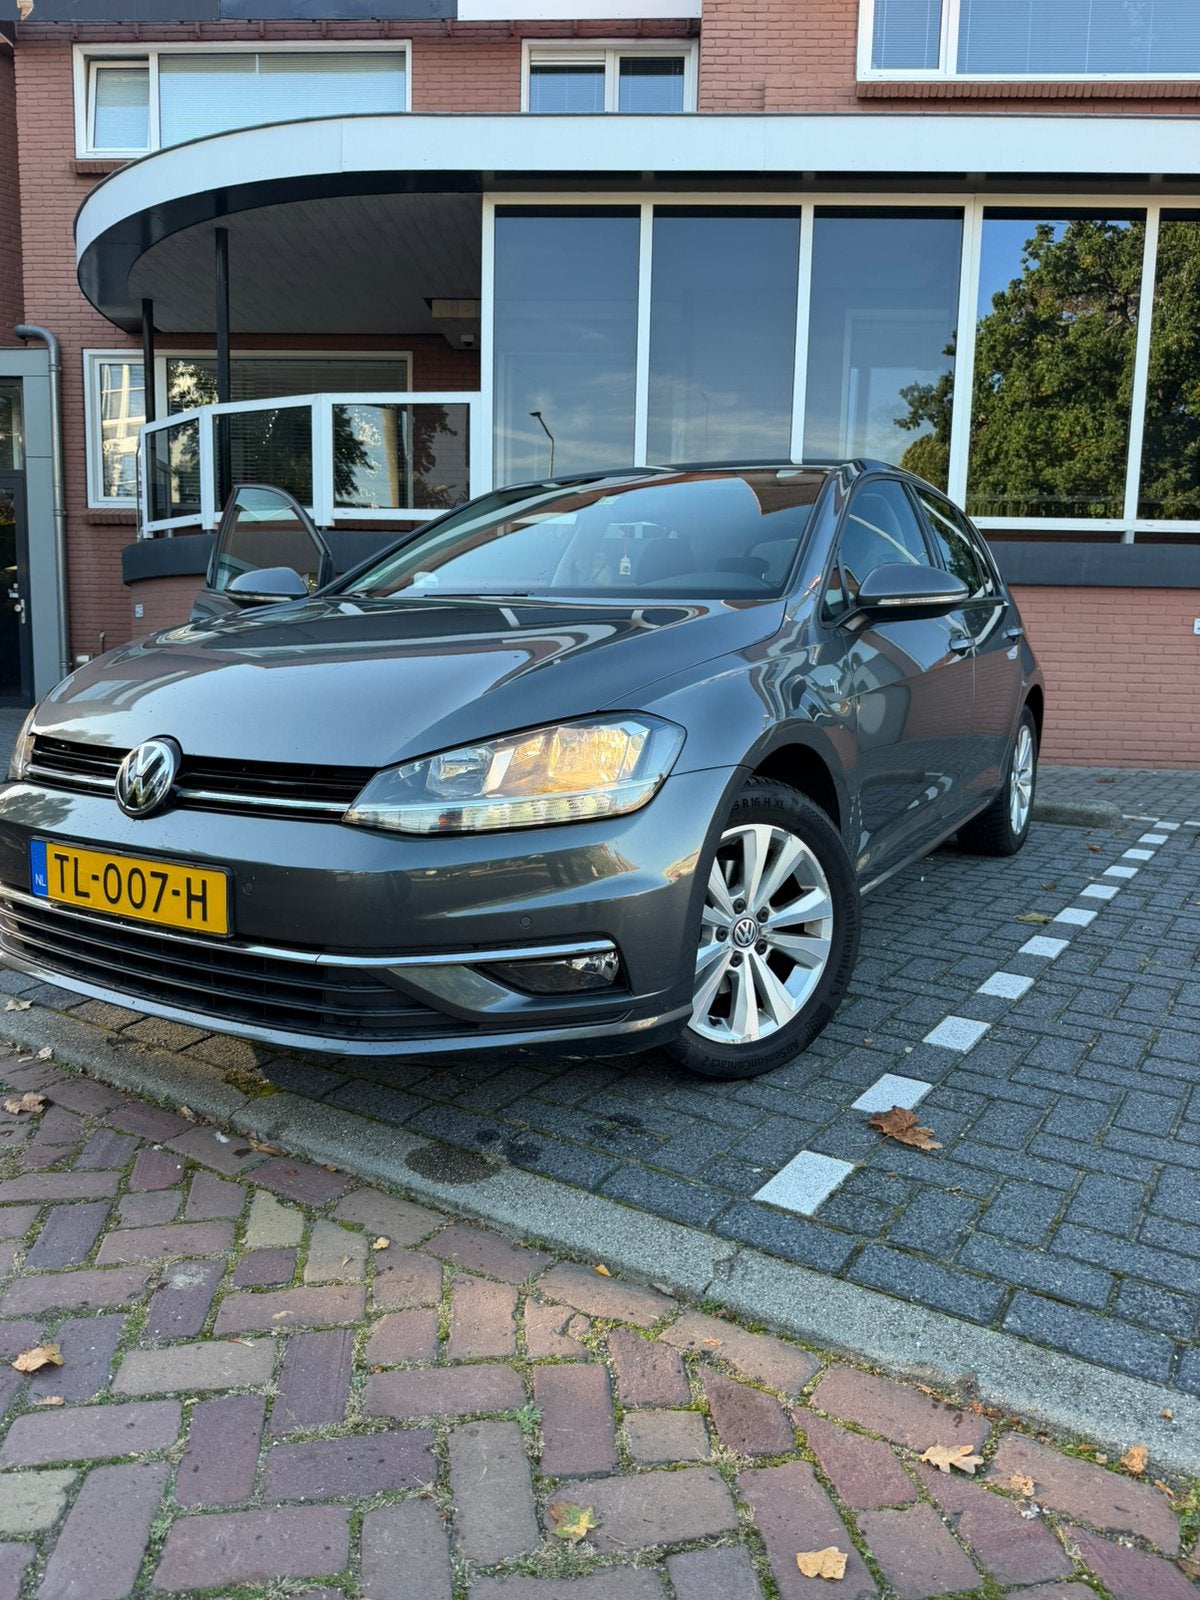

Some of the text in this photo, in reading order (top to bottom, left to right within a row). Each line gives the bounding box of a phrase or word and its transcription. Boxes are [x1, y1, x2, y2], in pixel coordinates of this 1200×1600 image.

[763, 797, 771, 809] H
[774, 799, 785, 810] XL
[34, 873, 47, 887] NL
[54, 853, 208, 922] TL-007-H
[834, 894, 857, 986] Continental
[702, 1039, 800, 1071] AllSeasonContact 2
